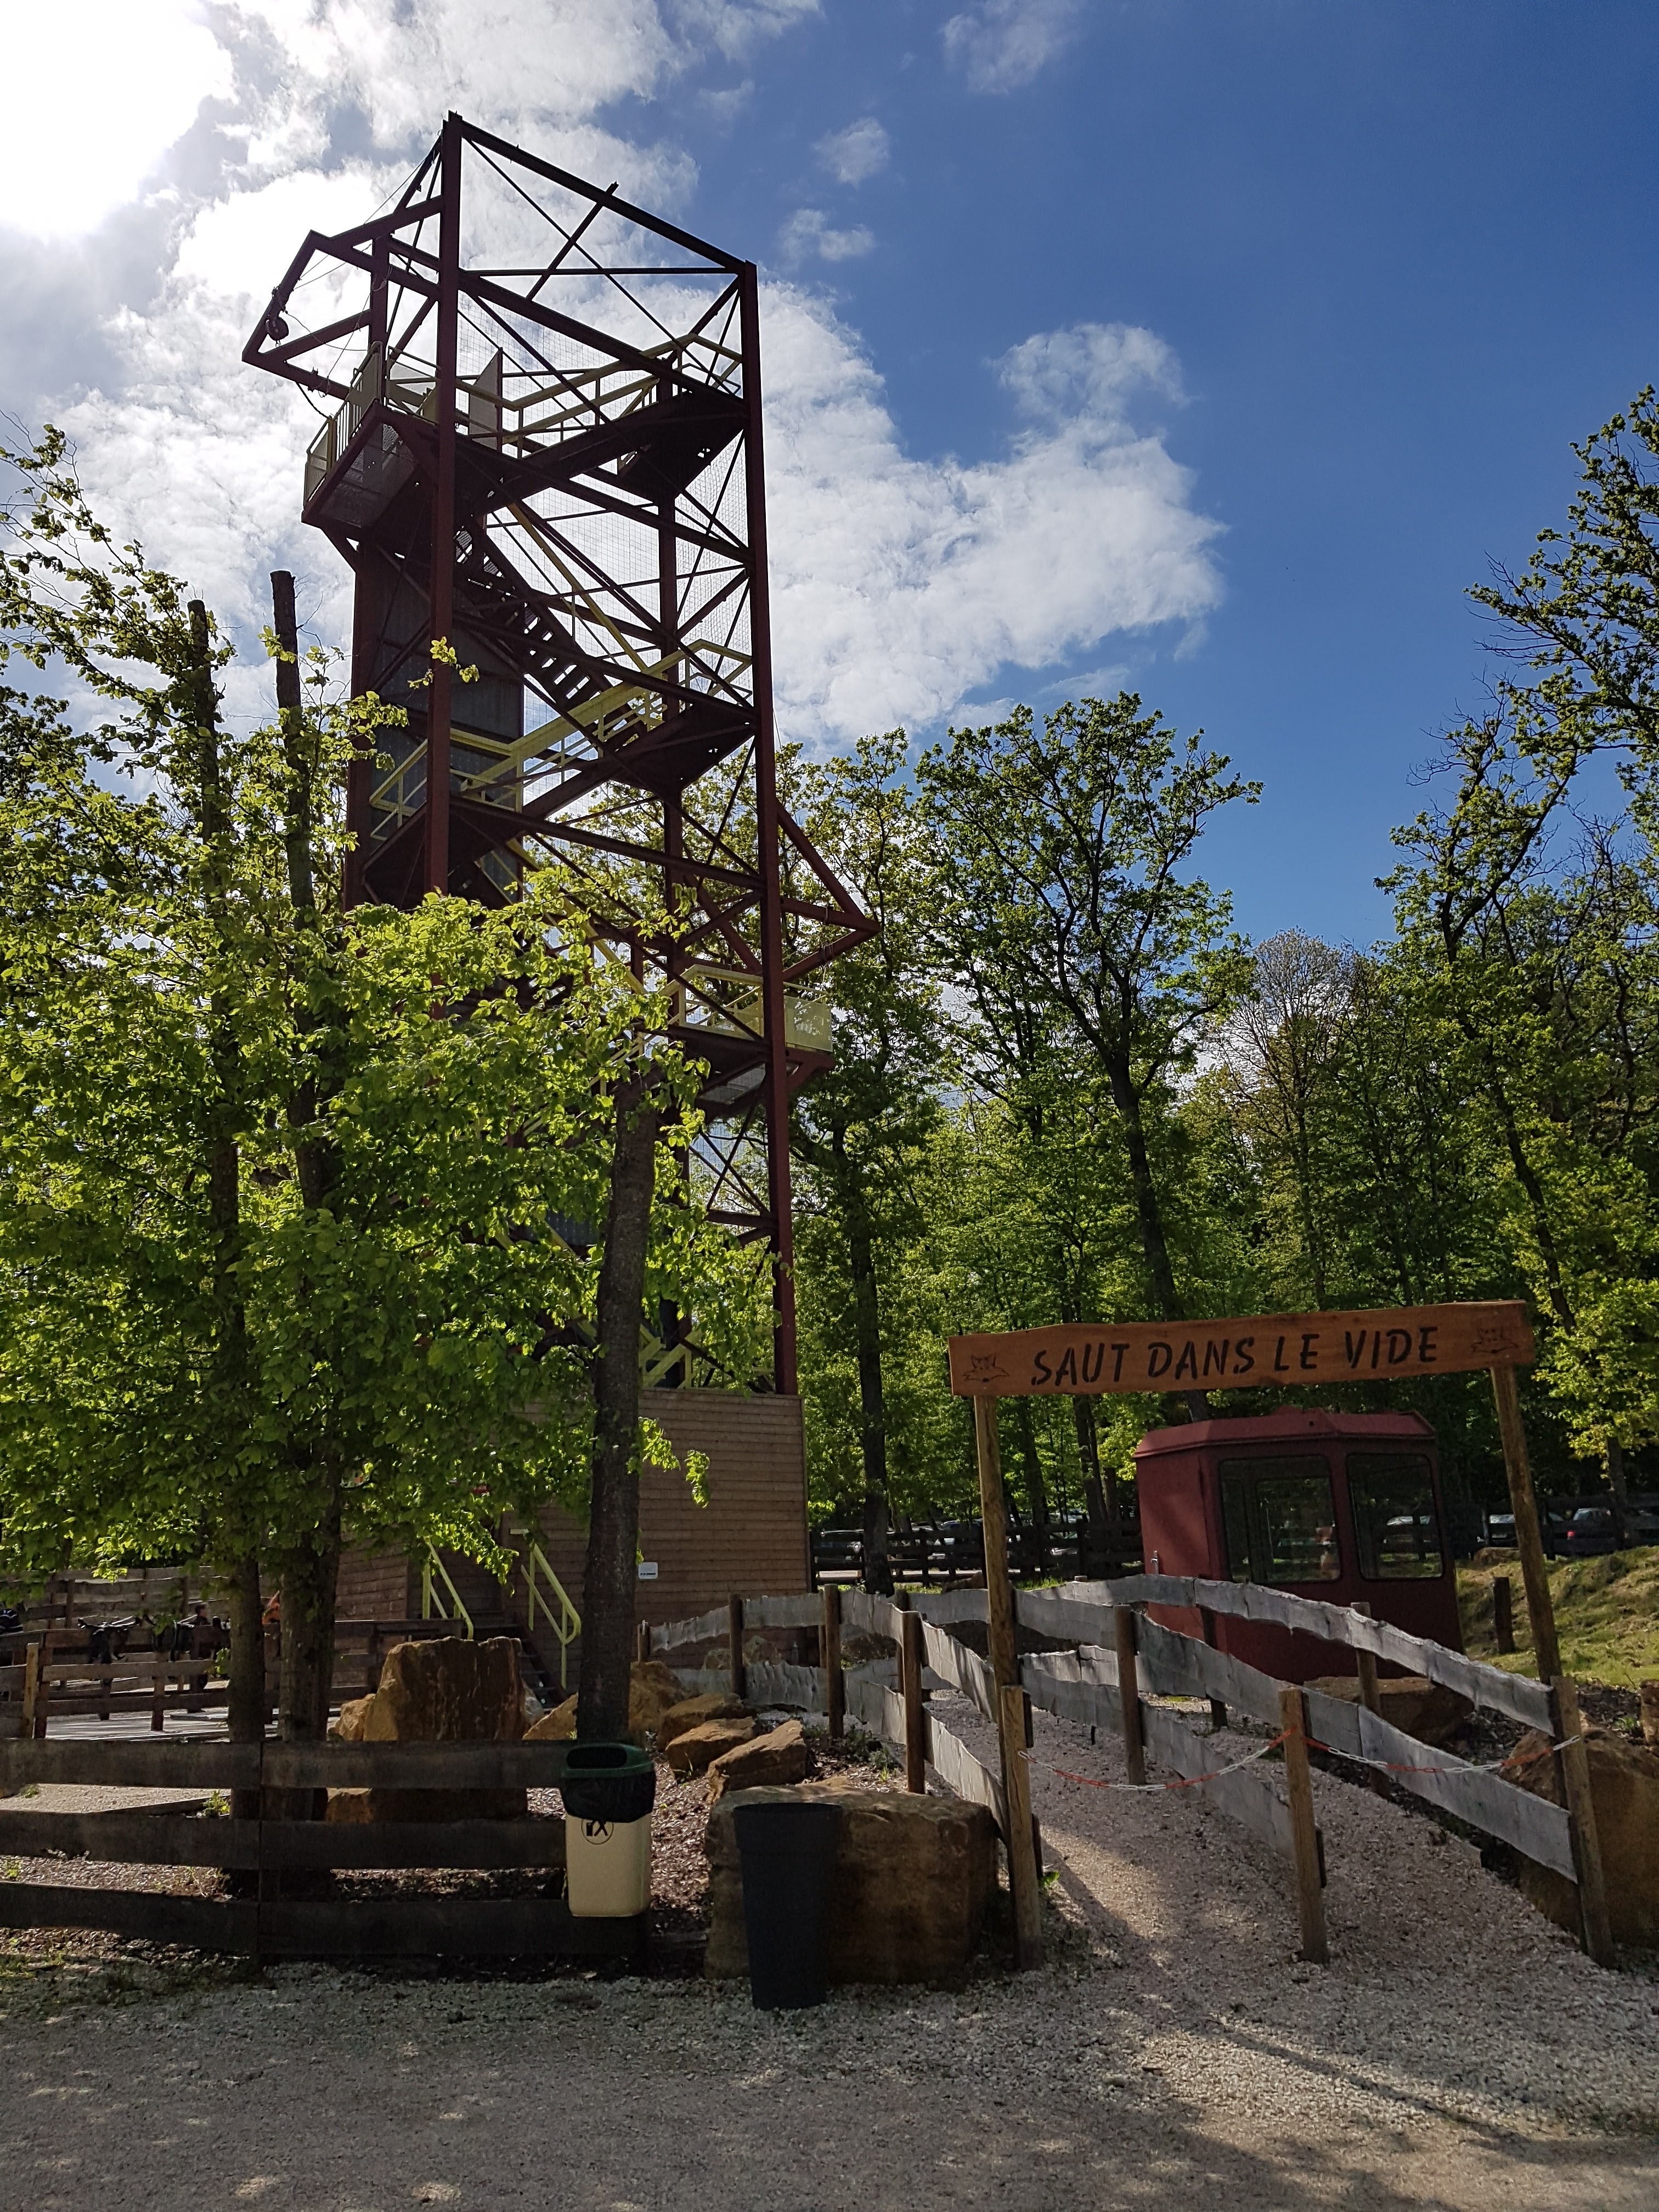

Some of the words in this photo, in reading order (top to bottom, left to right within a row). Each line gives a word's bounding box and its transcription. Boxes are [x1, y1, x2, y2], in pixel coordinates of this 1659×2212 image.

[1031, 1342, 1130, 1387] SAUT
[1148, 1336, 1255, 1380] DANS
[1273, 1333, 1320, 1371] LE
[1344, 1326, 1438, 1369] VIDE
